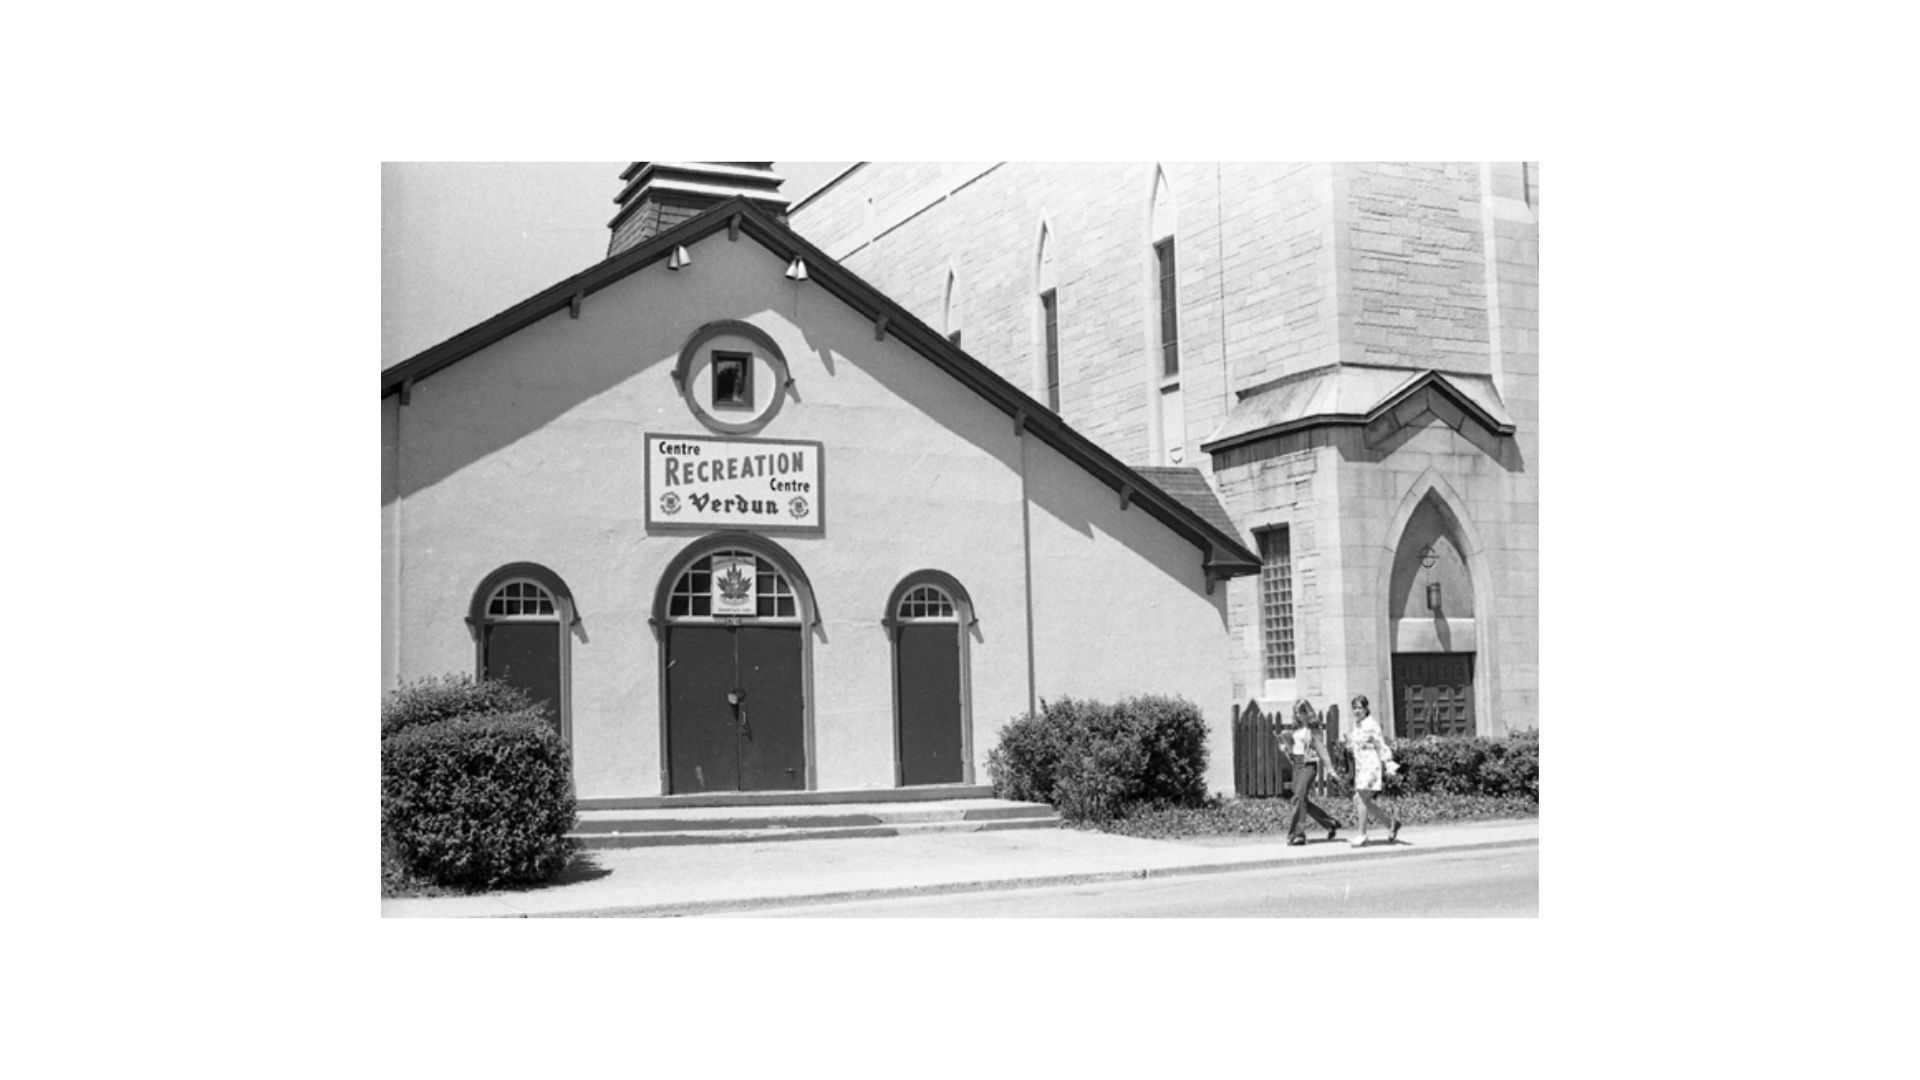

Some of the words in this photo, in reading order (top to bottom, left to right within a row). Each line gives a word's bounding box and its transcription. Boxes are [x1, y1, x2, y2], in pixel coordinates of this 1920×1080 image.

[659, 441, 701, 456] Centre
[665, 451, 805, 487] RECREATION
[769, 477, 811, 493] Centre
[688, 492, 780, 515] Verdun
